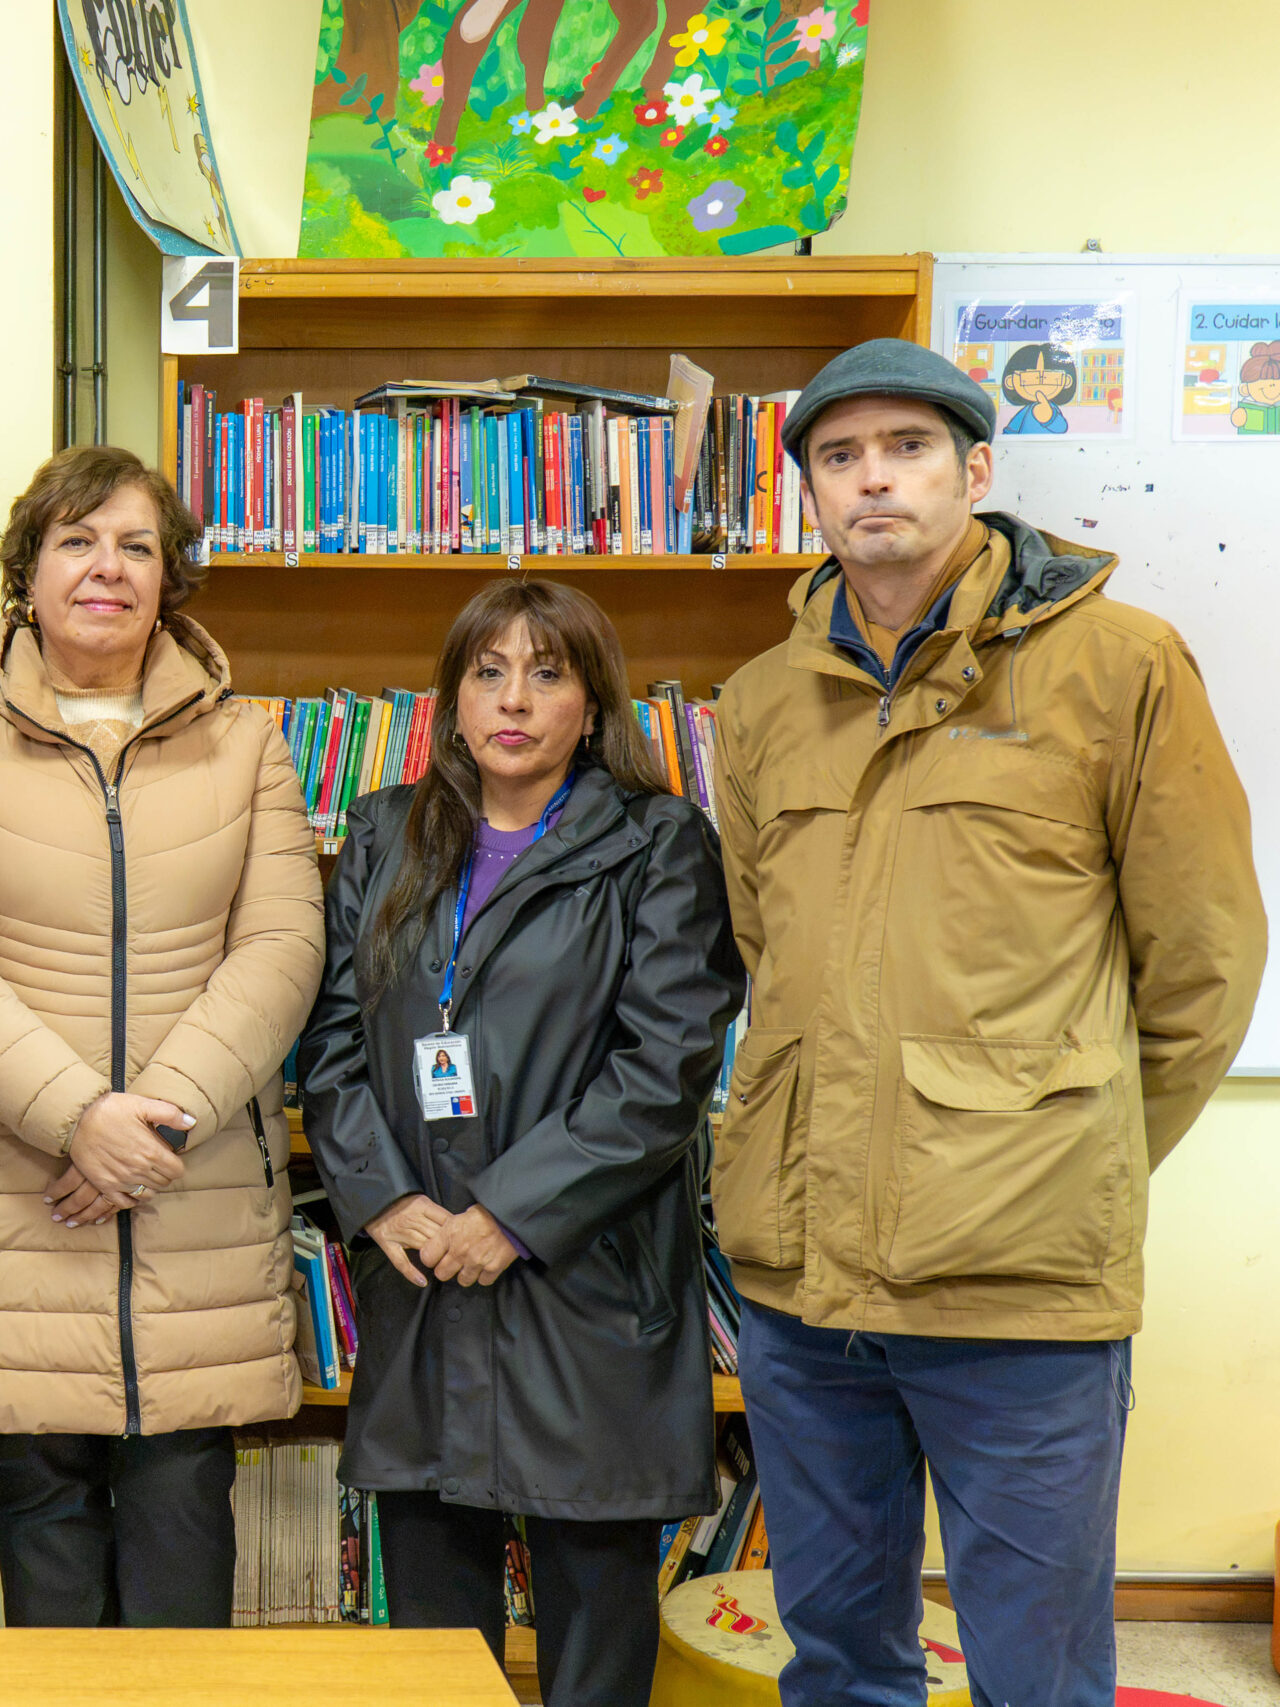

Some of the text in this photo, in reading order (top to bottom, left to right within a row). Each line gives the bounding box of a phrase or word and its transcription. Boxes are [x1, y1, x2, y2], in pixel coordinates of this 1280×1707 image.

[169, 261, 235, 348] 4
[974, 313, 1048, 330] Guardar
[1194, 313, 1208, 329] 2.
[1213, 312, 1270, 329] Cuidar
[286, 553, 298, 567] S
[509, 556, 521, 569] S
[714, 556, 725, 569] S
